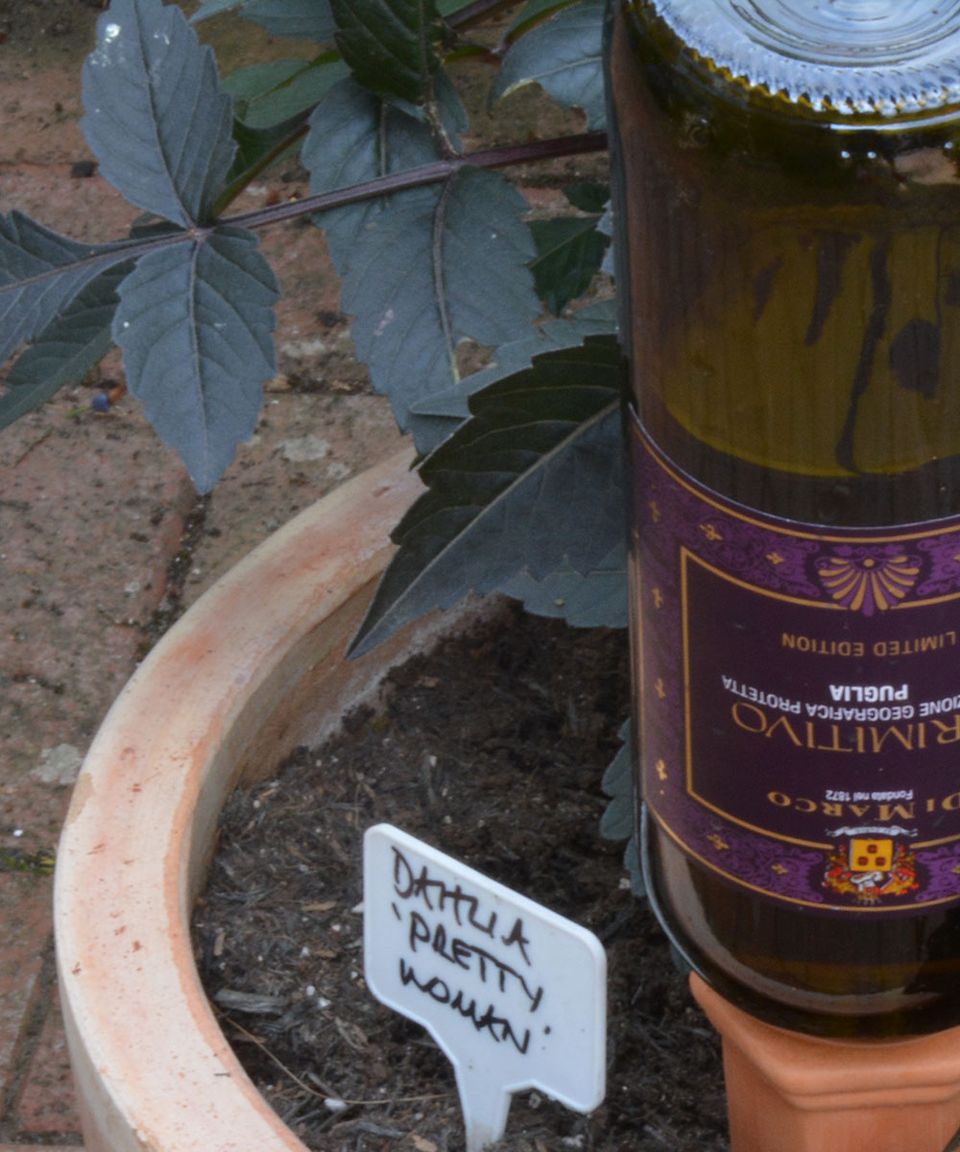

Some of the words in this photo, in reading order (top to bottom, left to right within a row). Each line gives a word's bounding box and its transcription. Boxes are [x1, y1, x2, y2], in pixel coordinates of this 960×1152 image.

[781, 632, 864, 656] EDITION
[873, 630, 956, 657] LIMITED
[722, 675, 801, 714] PROTETTA
[829, 684, 908, 702] PUGLIA
[806, 703, 914, 721] GEOGRAFICA
[825, 789, 851, 801] 1872
[854, 792, 870, 802] nel
[872, 789, 913, 801] Fondata
[767, 791, 915, 821] MARCO
